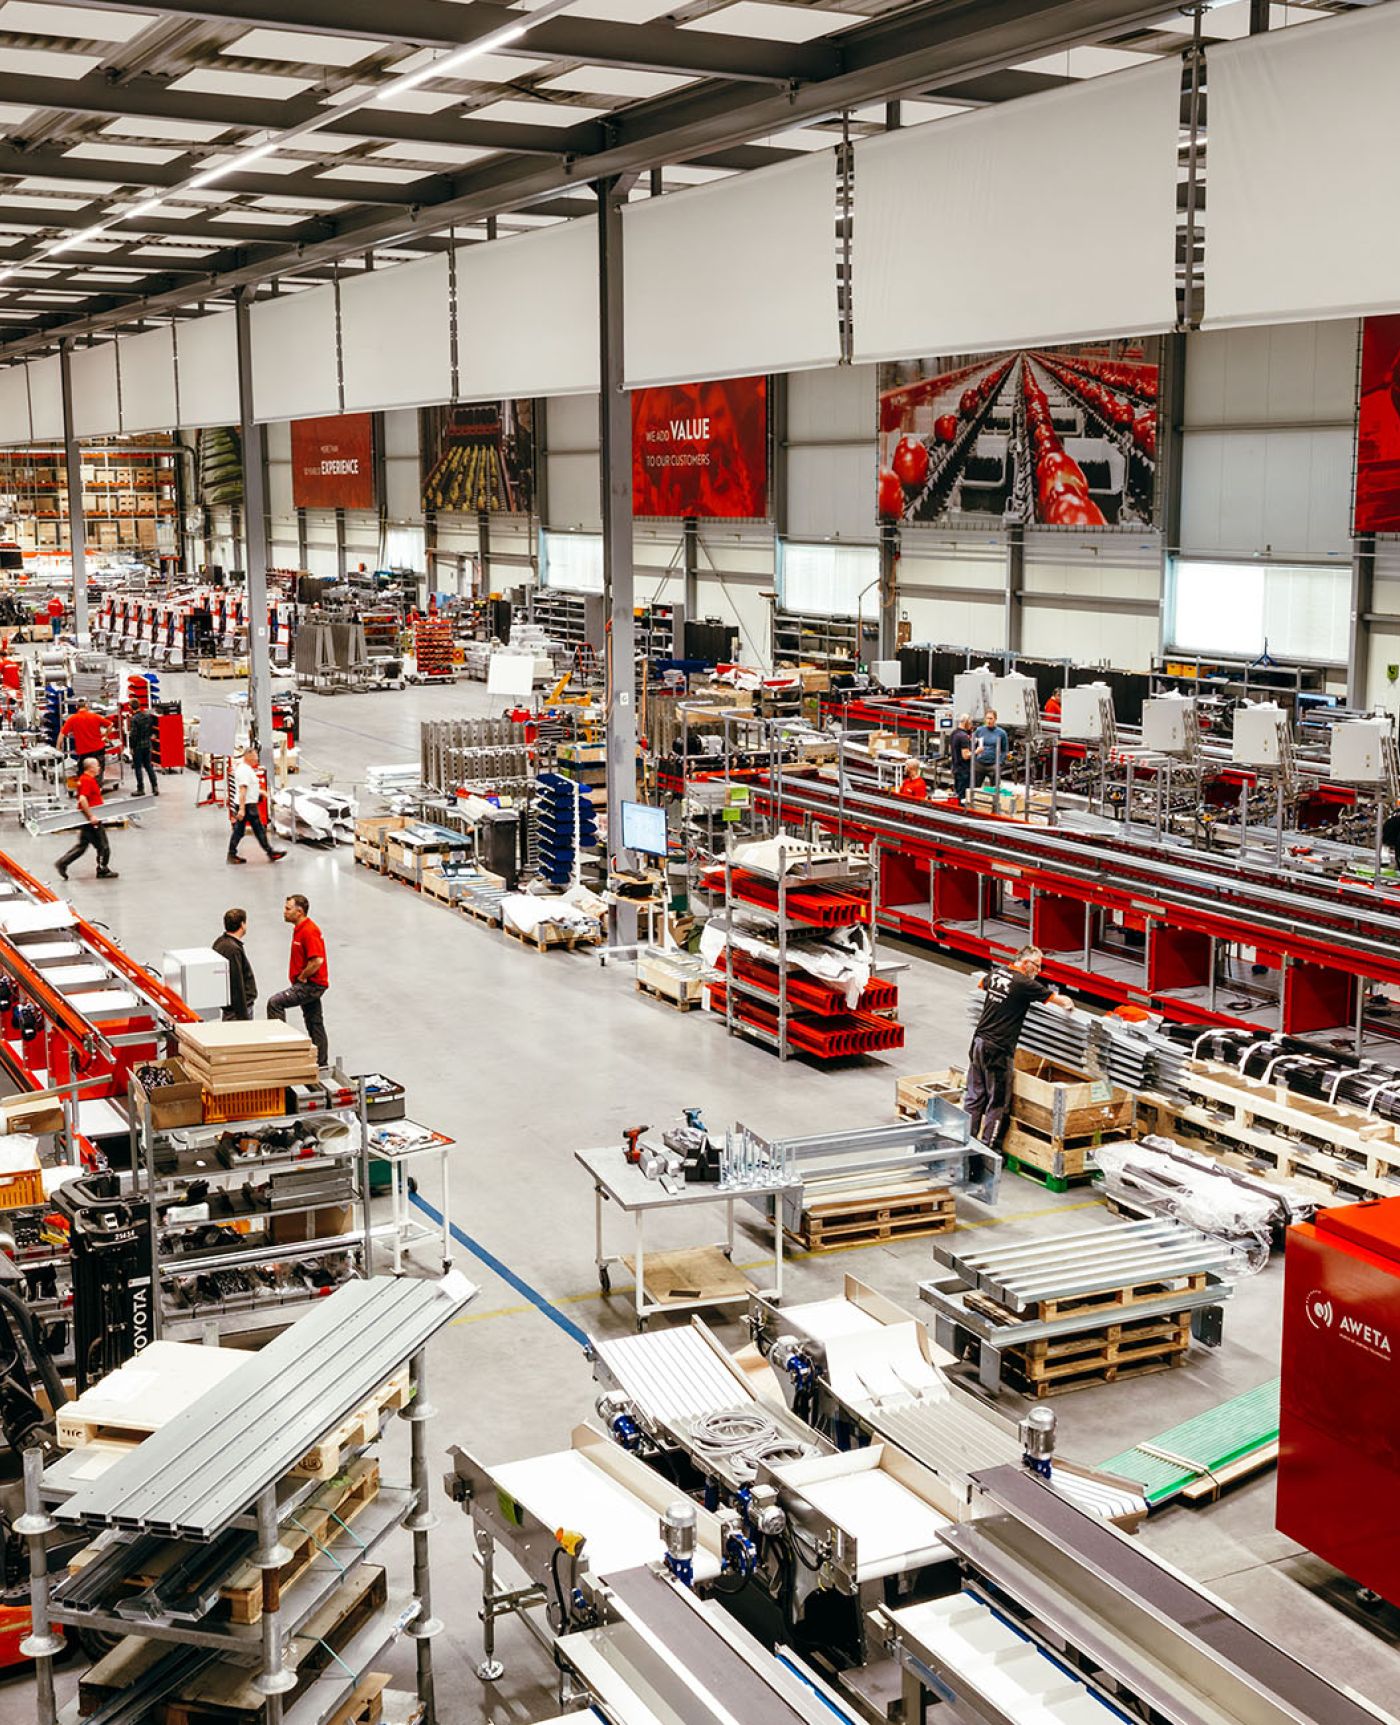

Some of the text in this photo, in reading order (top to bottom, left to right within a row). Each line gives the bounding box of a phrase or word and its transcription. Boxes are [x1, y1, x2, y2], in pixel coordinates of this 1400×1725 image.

[646, 417, 710, 442] WE ADD VALUE
[321, 459, 359, 475] EXPERIENCE
[646, 453, 710, 467] TO OUR CUSTOMERS
[1339, 1316, 1391, 1352] AWETA
